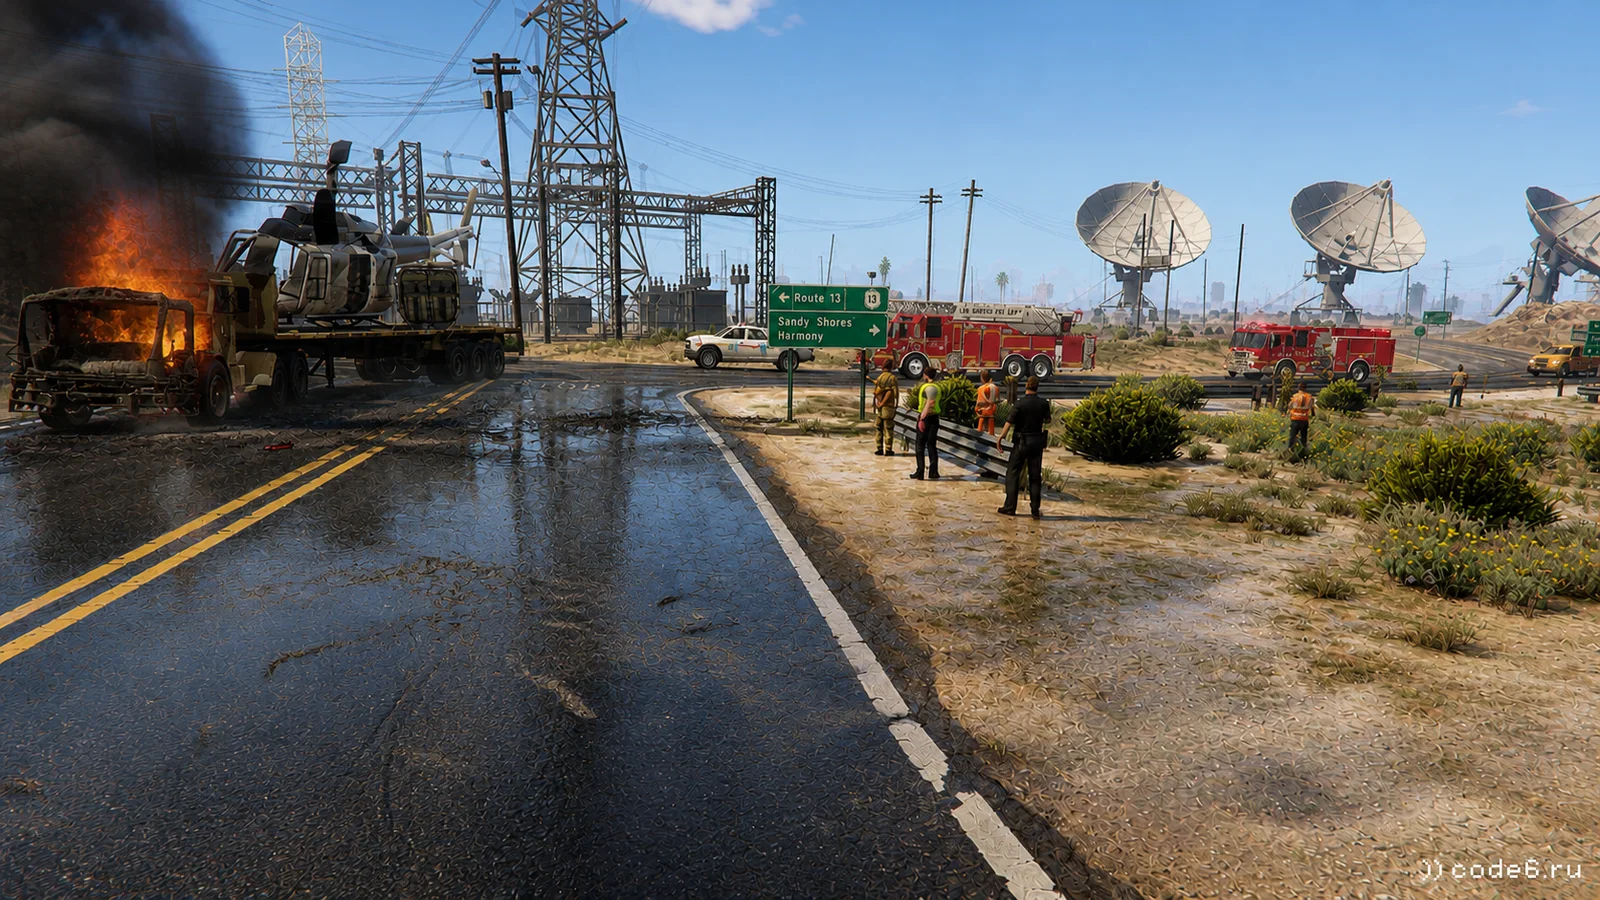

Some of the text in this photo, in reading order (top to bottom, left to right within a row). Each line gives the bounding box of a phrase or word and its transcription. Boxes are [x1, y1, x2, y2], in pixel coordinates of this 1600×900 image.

[794, 292, 841, 303] Route 13
[868, 294, 877, 304] 13
[778, 316, 852, 328] Sandy Shores
[778, 330, 824, 343] Harmony
